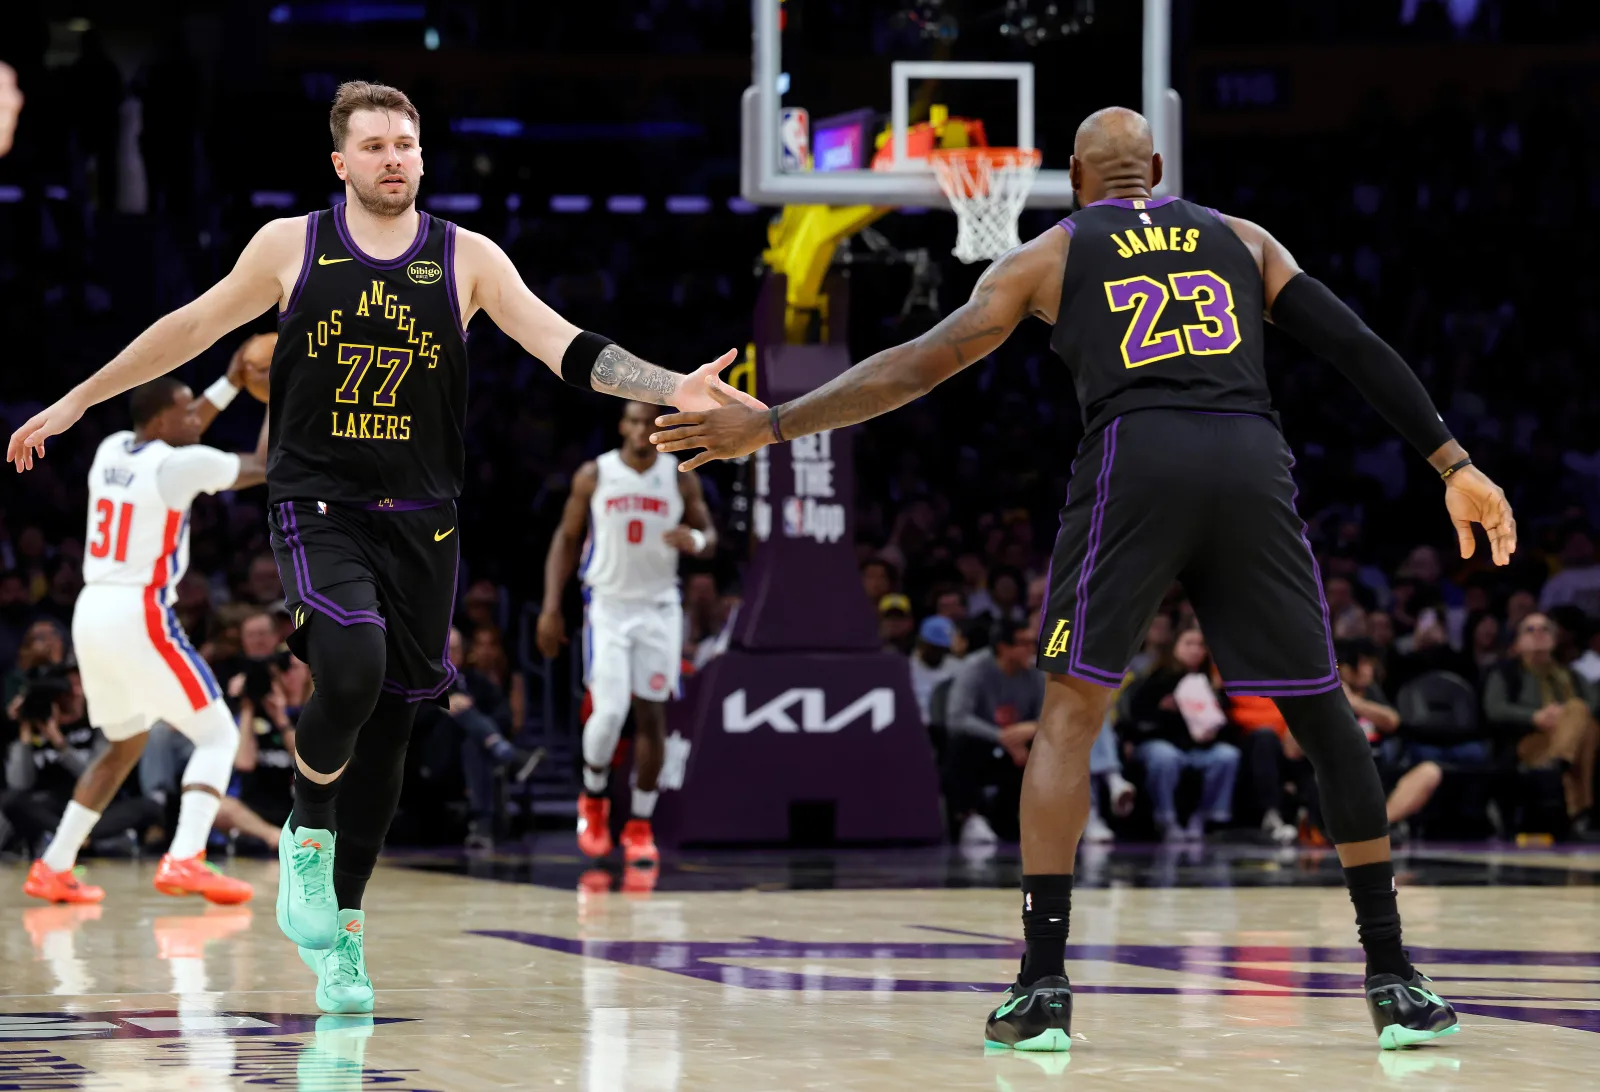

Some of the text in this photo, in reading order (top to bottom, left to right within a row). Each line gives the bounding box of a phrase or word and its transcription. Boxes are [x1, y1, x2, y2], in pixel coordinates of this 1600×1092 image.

[1110, 226, 1200, 258] JAMES
[410, 266, 440, 278] bibigo
[307, 280, 441, 369] LOS ANGELES
[1103, 269, 1242, 369] 23
[335, 342, 414, 407] 77
[331, 411, 411, 440] LAKERS
[90, 498, 134, 563] 31
[626, 518, 645, 544] 0
[1043, 618, 1071, 658] LA
[722, 687, 896, 734] KIA
